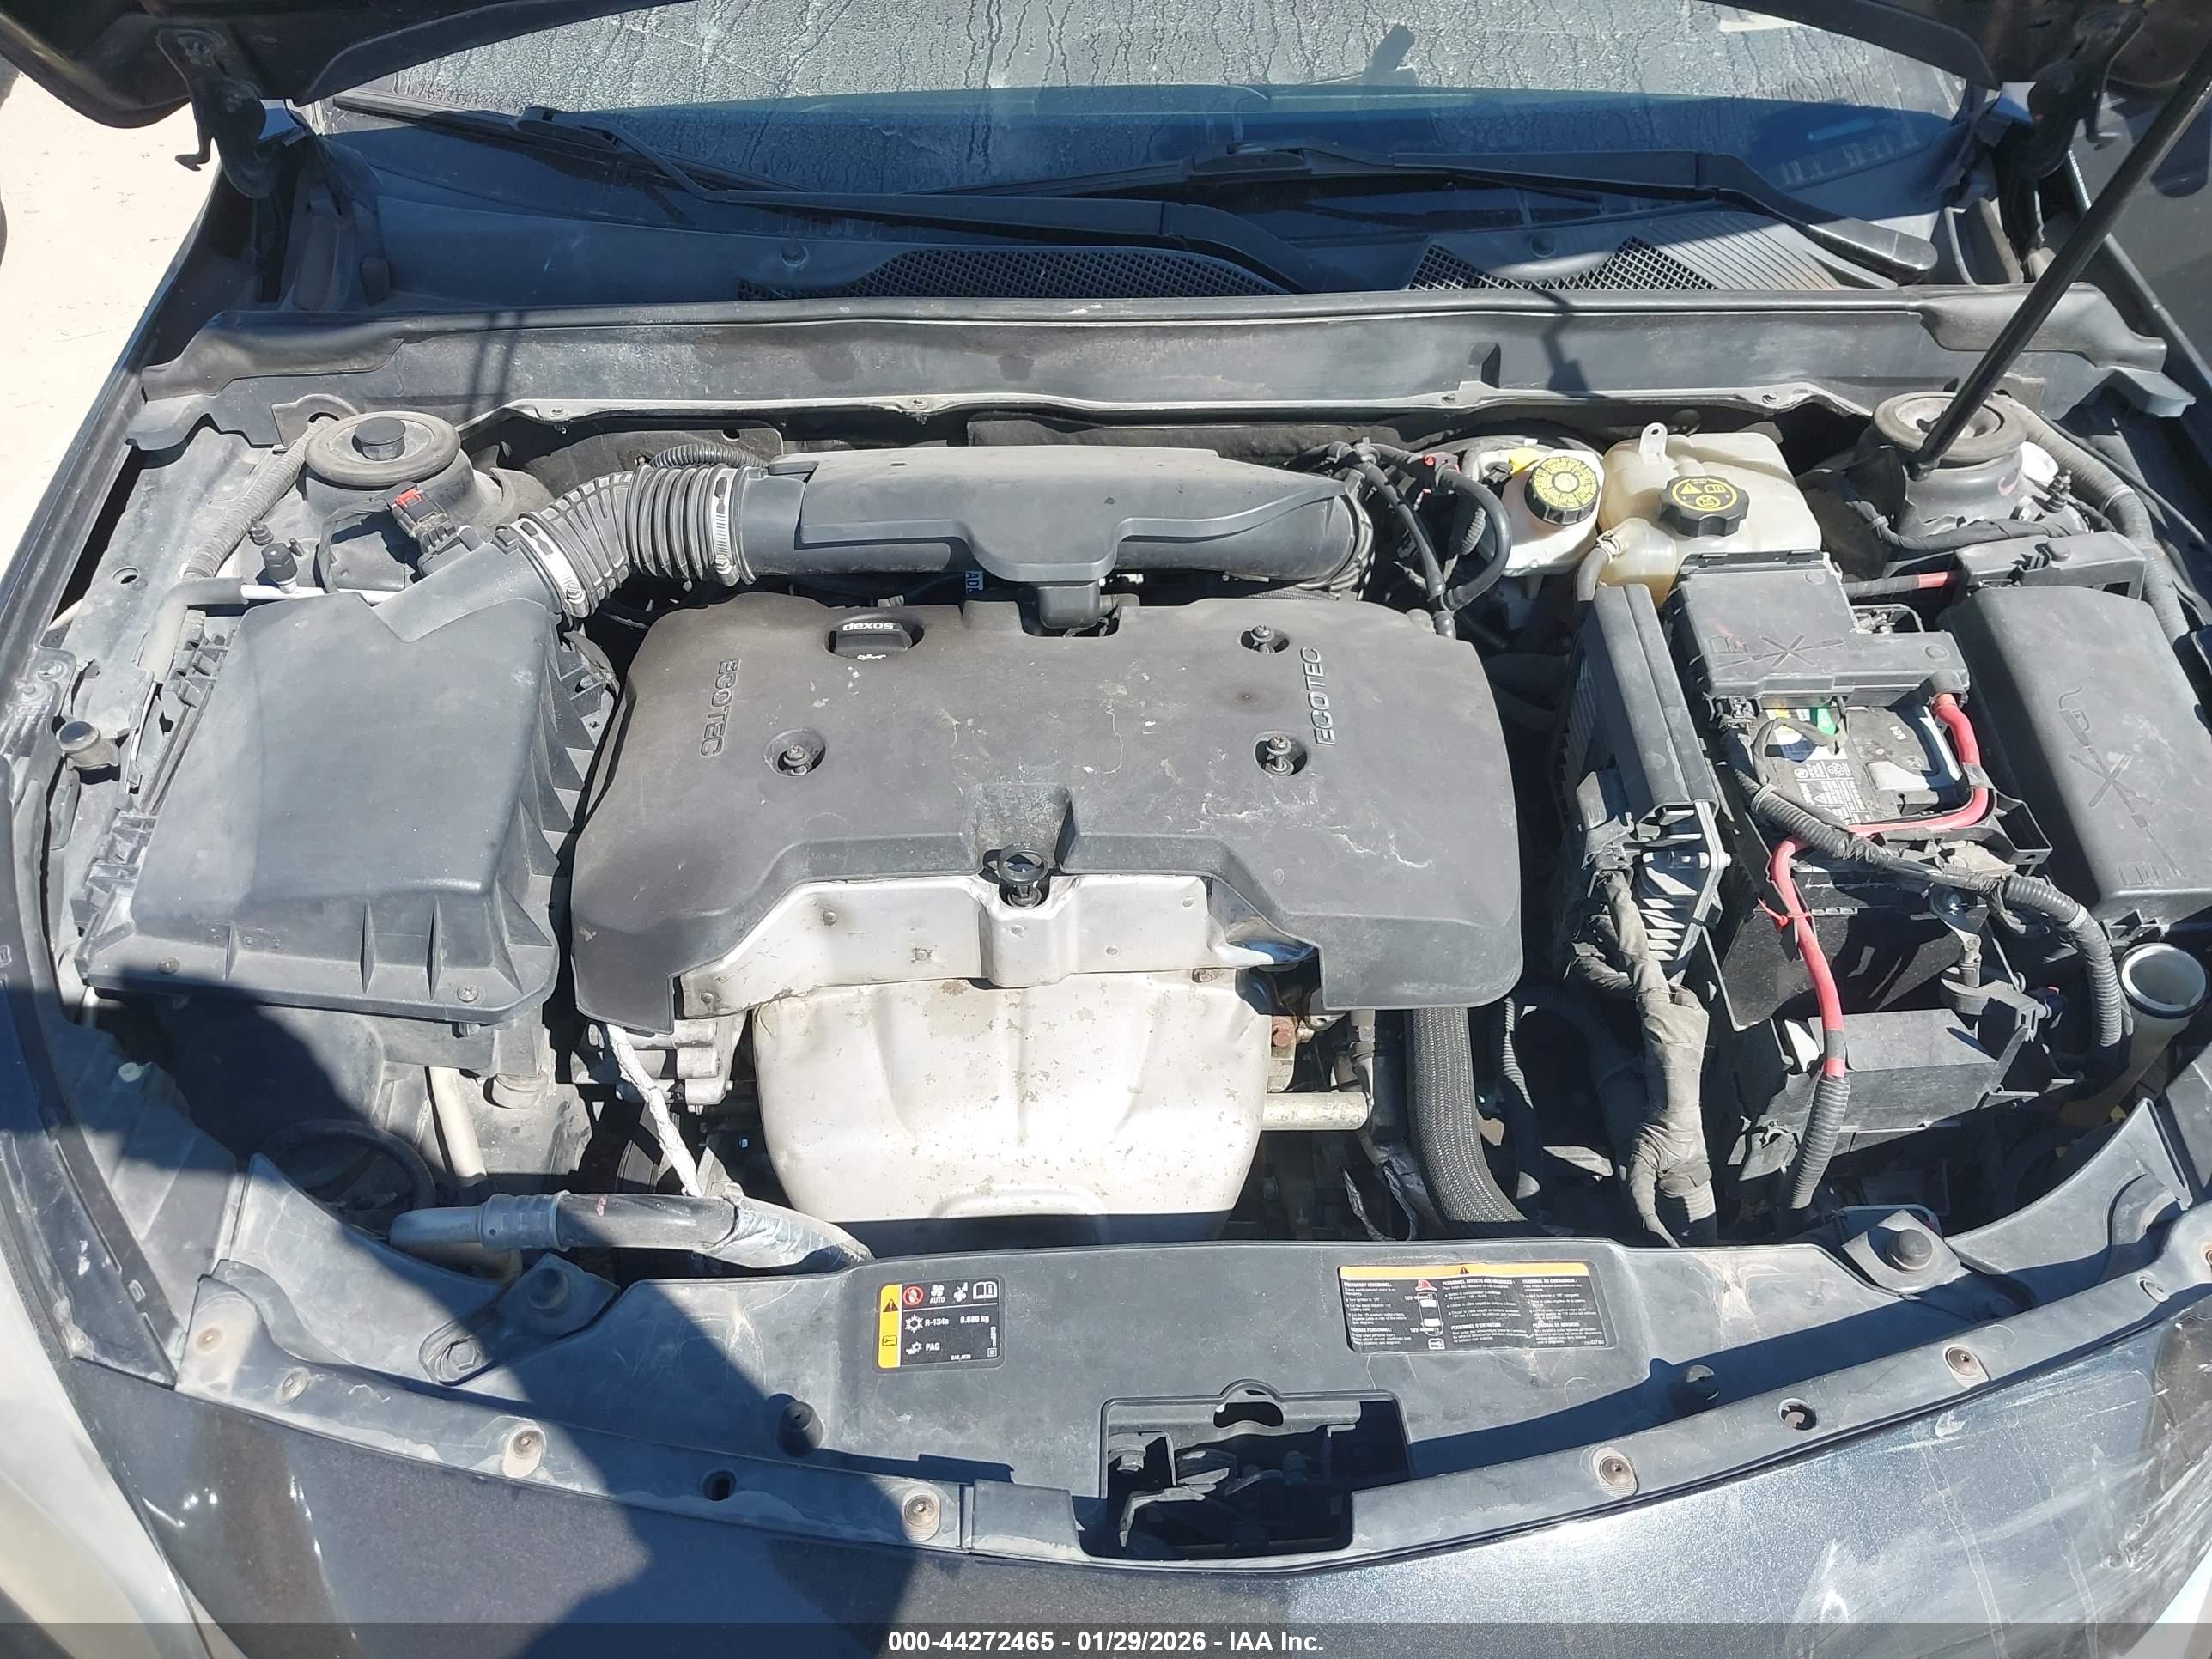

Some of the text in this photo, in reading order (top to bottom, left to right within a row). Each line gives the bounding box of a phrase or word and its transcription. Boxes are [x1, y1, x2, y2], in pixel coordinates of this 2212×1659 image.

[842, 622, 894, 631] dexos
[1299, 647, 1336, 745] ECOTEC
[700, 658, 741, 757] ECOTEC
[925, 1318, 949, 1327] R-134a
[981, 1315, 990, 1323] kg
[925, 1342, 940, 1352] PAG
